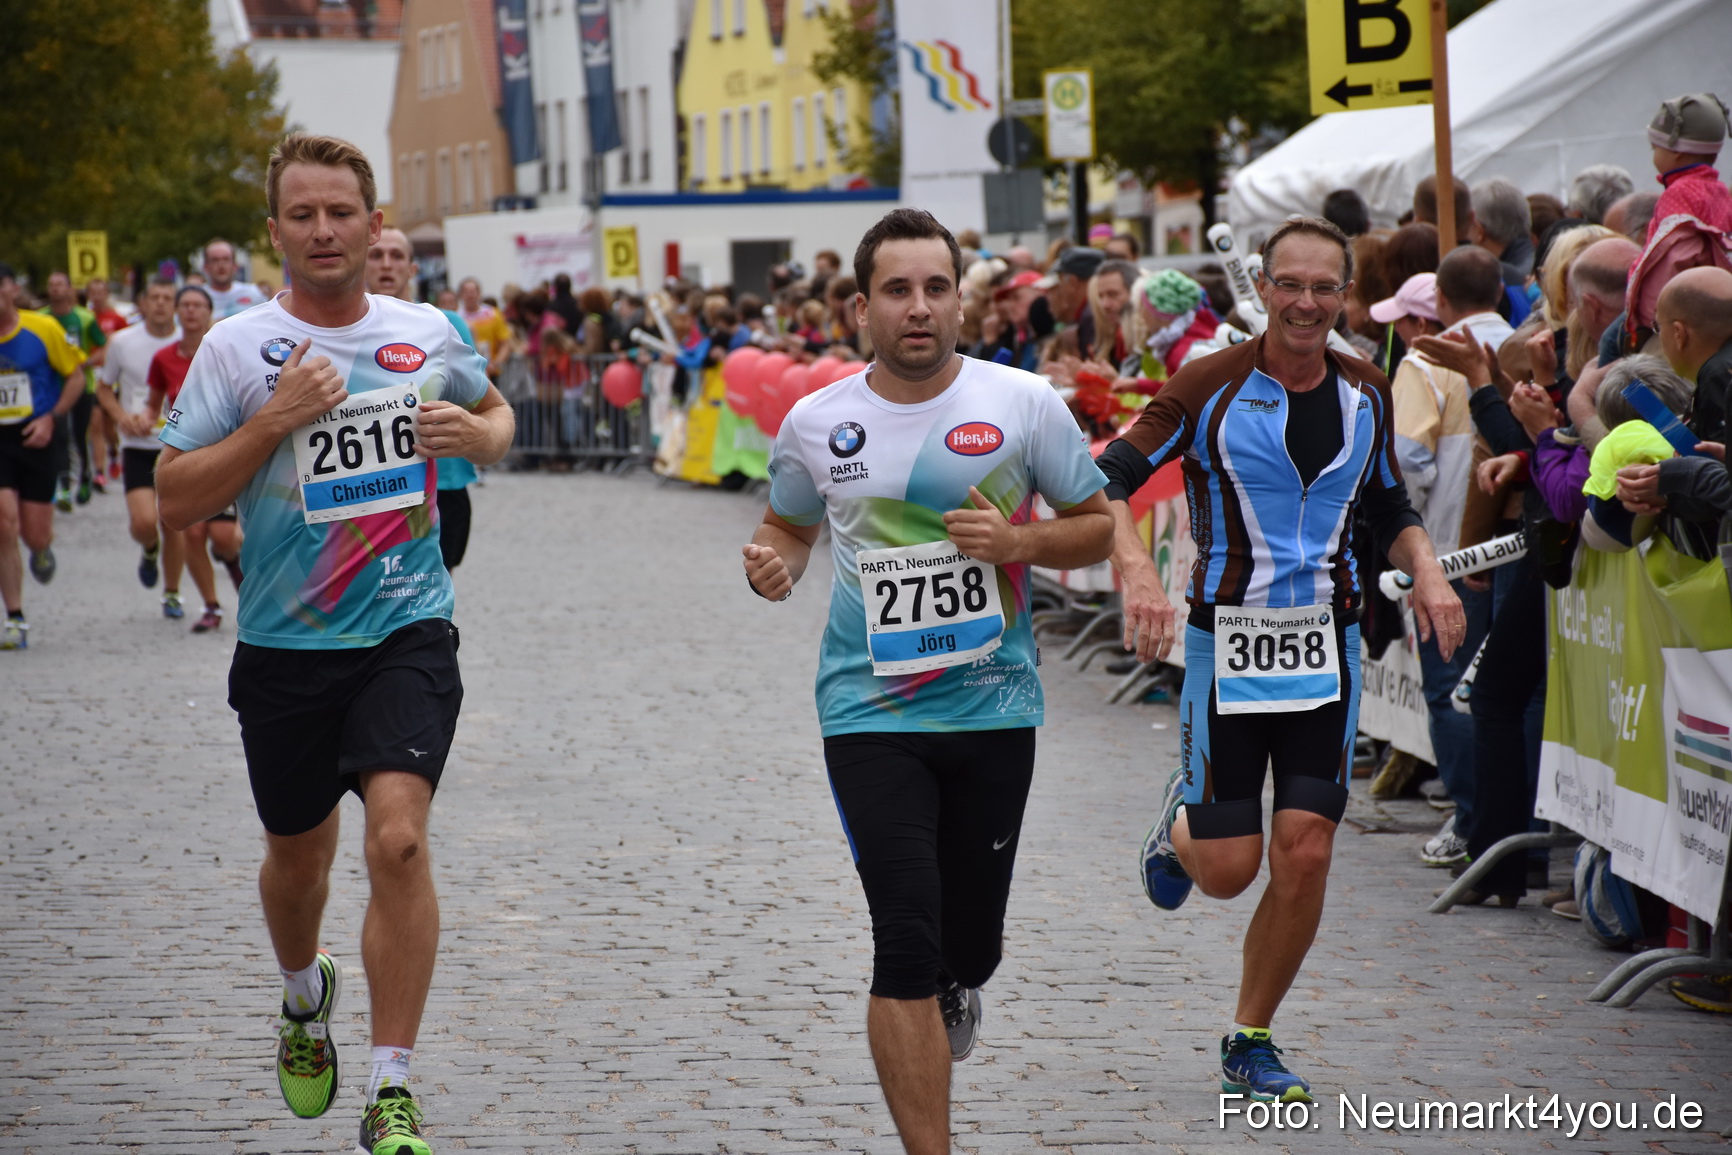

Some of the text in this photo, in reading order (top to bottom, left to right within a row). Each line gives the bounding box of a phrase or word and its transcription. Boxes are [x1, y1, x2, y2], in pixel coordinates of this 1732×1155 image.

[1343, 0, 1411, 65] B
[79, 250, 98, 275] D
[612, 241, 632, 267] D
[1225, 257, 1253, 295] BMW
[382, 350, 422, 366] Hervis
[339, 399, 400, 420] Neumarkt
[832, 422, 863, 435] BMW
[953, 430, 998, 447] Hervis
[308, 414, 416, 476] 2616
[830, 461, 869, 477] PARTL
[832, 471, 869, 485] Neumarkt
[331, 476, 408, 503] Christian
[380, 554, 403, 575] 16.
[860, 560, 904, 575] PARTL
[1441, 549, 1478, 575] MW
[875, 566, 988, 626] 2758
[1218, 616, 1315, 629] PARTL Neumarkt
[917, 632, 957, 654] Jörg
[1227, 630, 1327, 672] 3058
